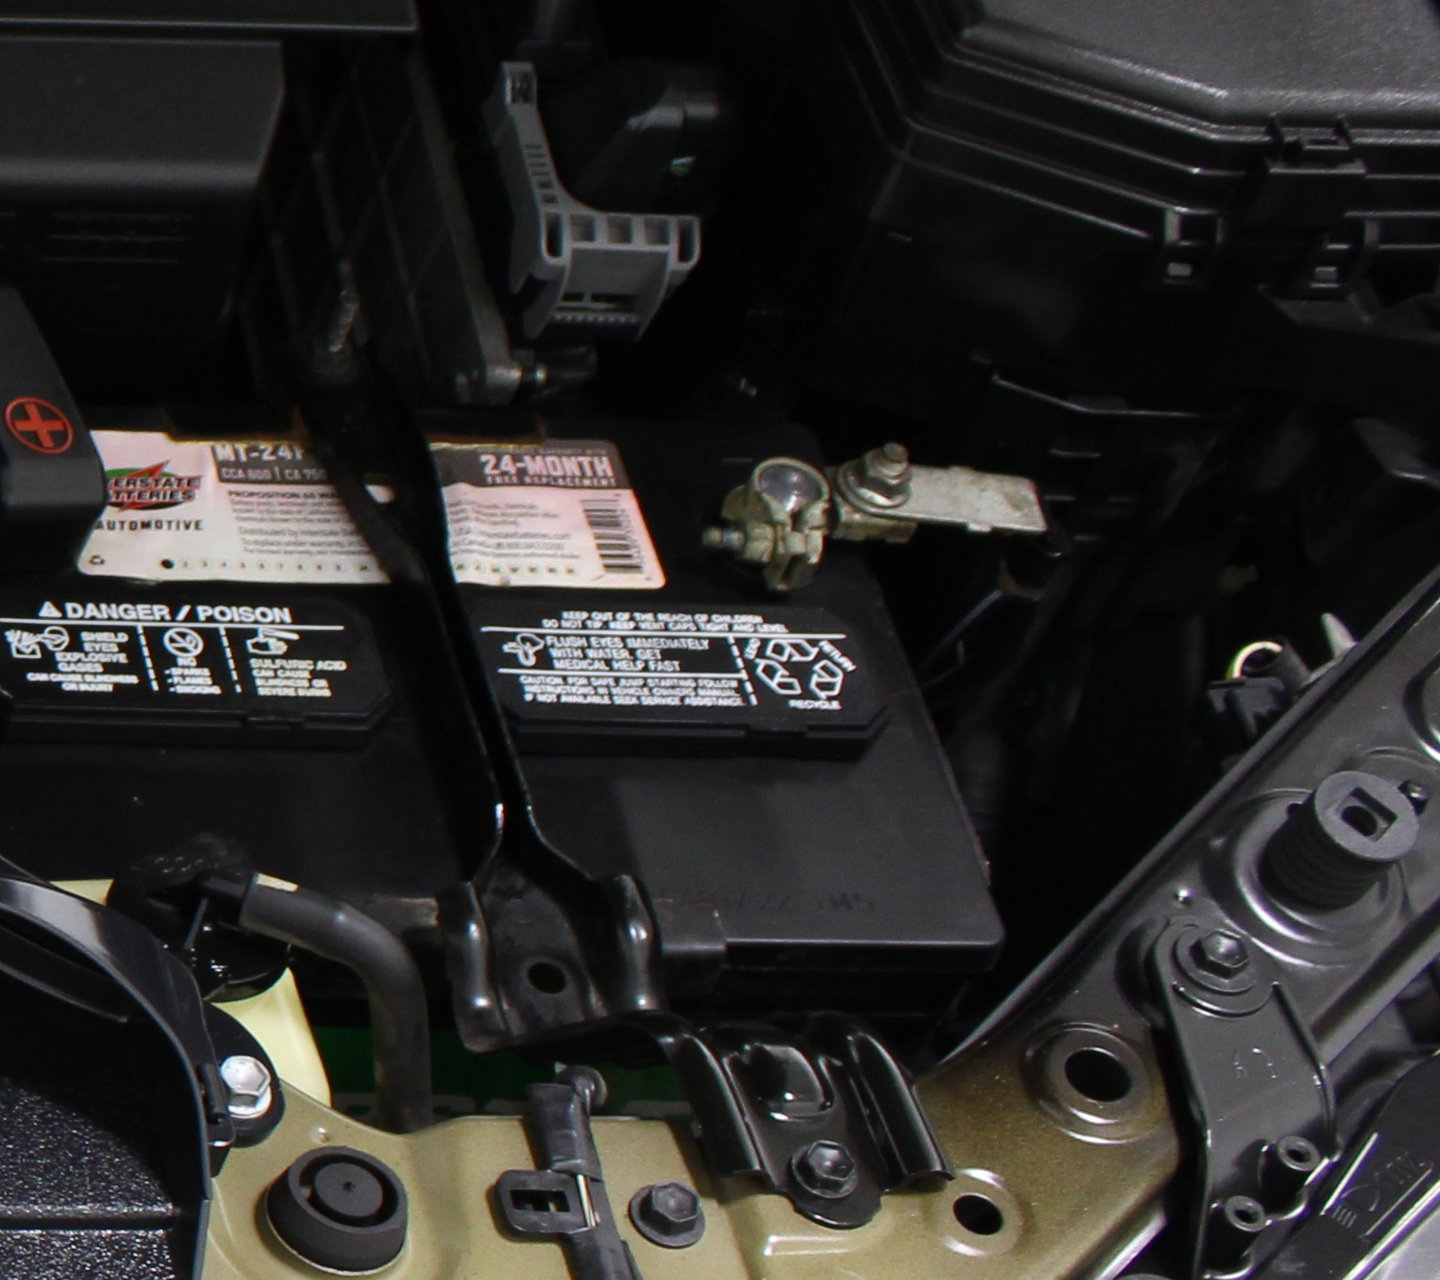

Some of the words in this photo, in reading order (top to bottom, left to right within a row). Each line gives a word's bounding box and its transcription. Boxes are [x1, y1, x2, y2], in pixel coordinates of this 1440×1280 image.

[480, 454, 615, 477] 24-MONTH
[110, 477, 201, 489] ERSTATE
[486, 476, 519, 484] FREE
[524, 477, 617, 486] REPLACEMENT
[111, 490, 195, 501] TTERIES
[94, 520, 203, 531] AUTOMOTIVE
[64, 602, 171, 621] DANGER
[196, 605, 292, 623] POISON
[561, 610, 590, 620] KEEP
[590, 611, 614, 621] OUT
[615, 611, 632, 621] OF
[632, 612, 656, 622] THE
[656, 612, 693, 622] REACH
[693, 613, 710, 622] OF
[541, 618, 560, 628] DO
[560, 619, 583, 629] NOT
[607, 620, 637, 630] KEEP
[637, 621, 666, 631] VENT
[666, 622, 698, 632] CAPS
[698, 622, 730, 632] TIGHT
[731, 623, 756, 633] AND
[80, 631, 129, 643] SHIELD
[545, 635, 589, 648] FLUSH
[589, 636, 625, 649] EYES
[624, 637, 710, 650] IMMEDIATELY
[83, 642, 120, 653] EYES
[548, 647, 584, 659] WITH
[634, 648, 662, 660] GET
[55, 652, 129, 663] EXPLOSIVE
[176, 656, 198, 667] NO
[57, 662, 104, 673] GASES
[249, 658, 315, 670] SULFURIC
[315, 660, 348, 671] ACID
[552, 658, 611, 670] MEDICAL
[611, 659, 646, 671] HELP
[646, 660, 681, 672] FAST
[83, 674, 140, 684] BLINDNESS
[254, 677, 311, 687] BLINDNESS
[565, 676, 589, 686] FOR
[589, 677, 617, 687] SAFE
[617, 677, 646, 687] JUMP
[646, 678, 697, 688] STARTING
[697, 678, 739, 689] FOLLOW
[523, 684, 596, 695] INSTRUCTIONS
[610, 686, 651, 696] VEHICLE
[535, 693, 558, 703] NOT
[559, 694, 613, 704] AVAILABLE
[612, 695, 640, 705] SEEK
[640, 696, 682, 706] SERVICE
